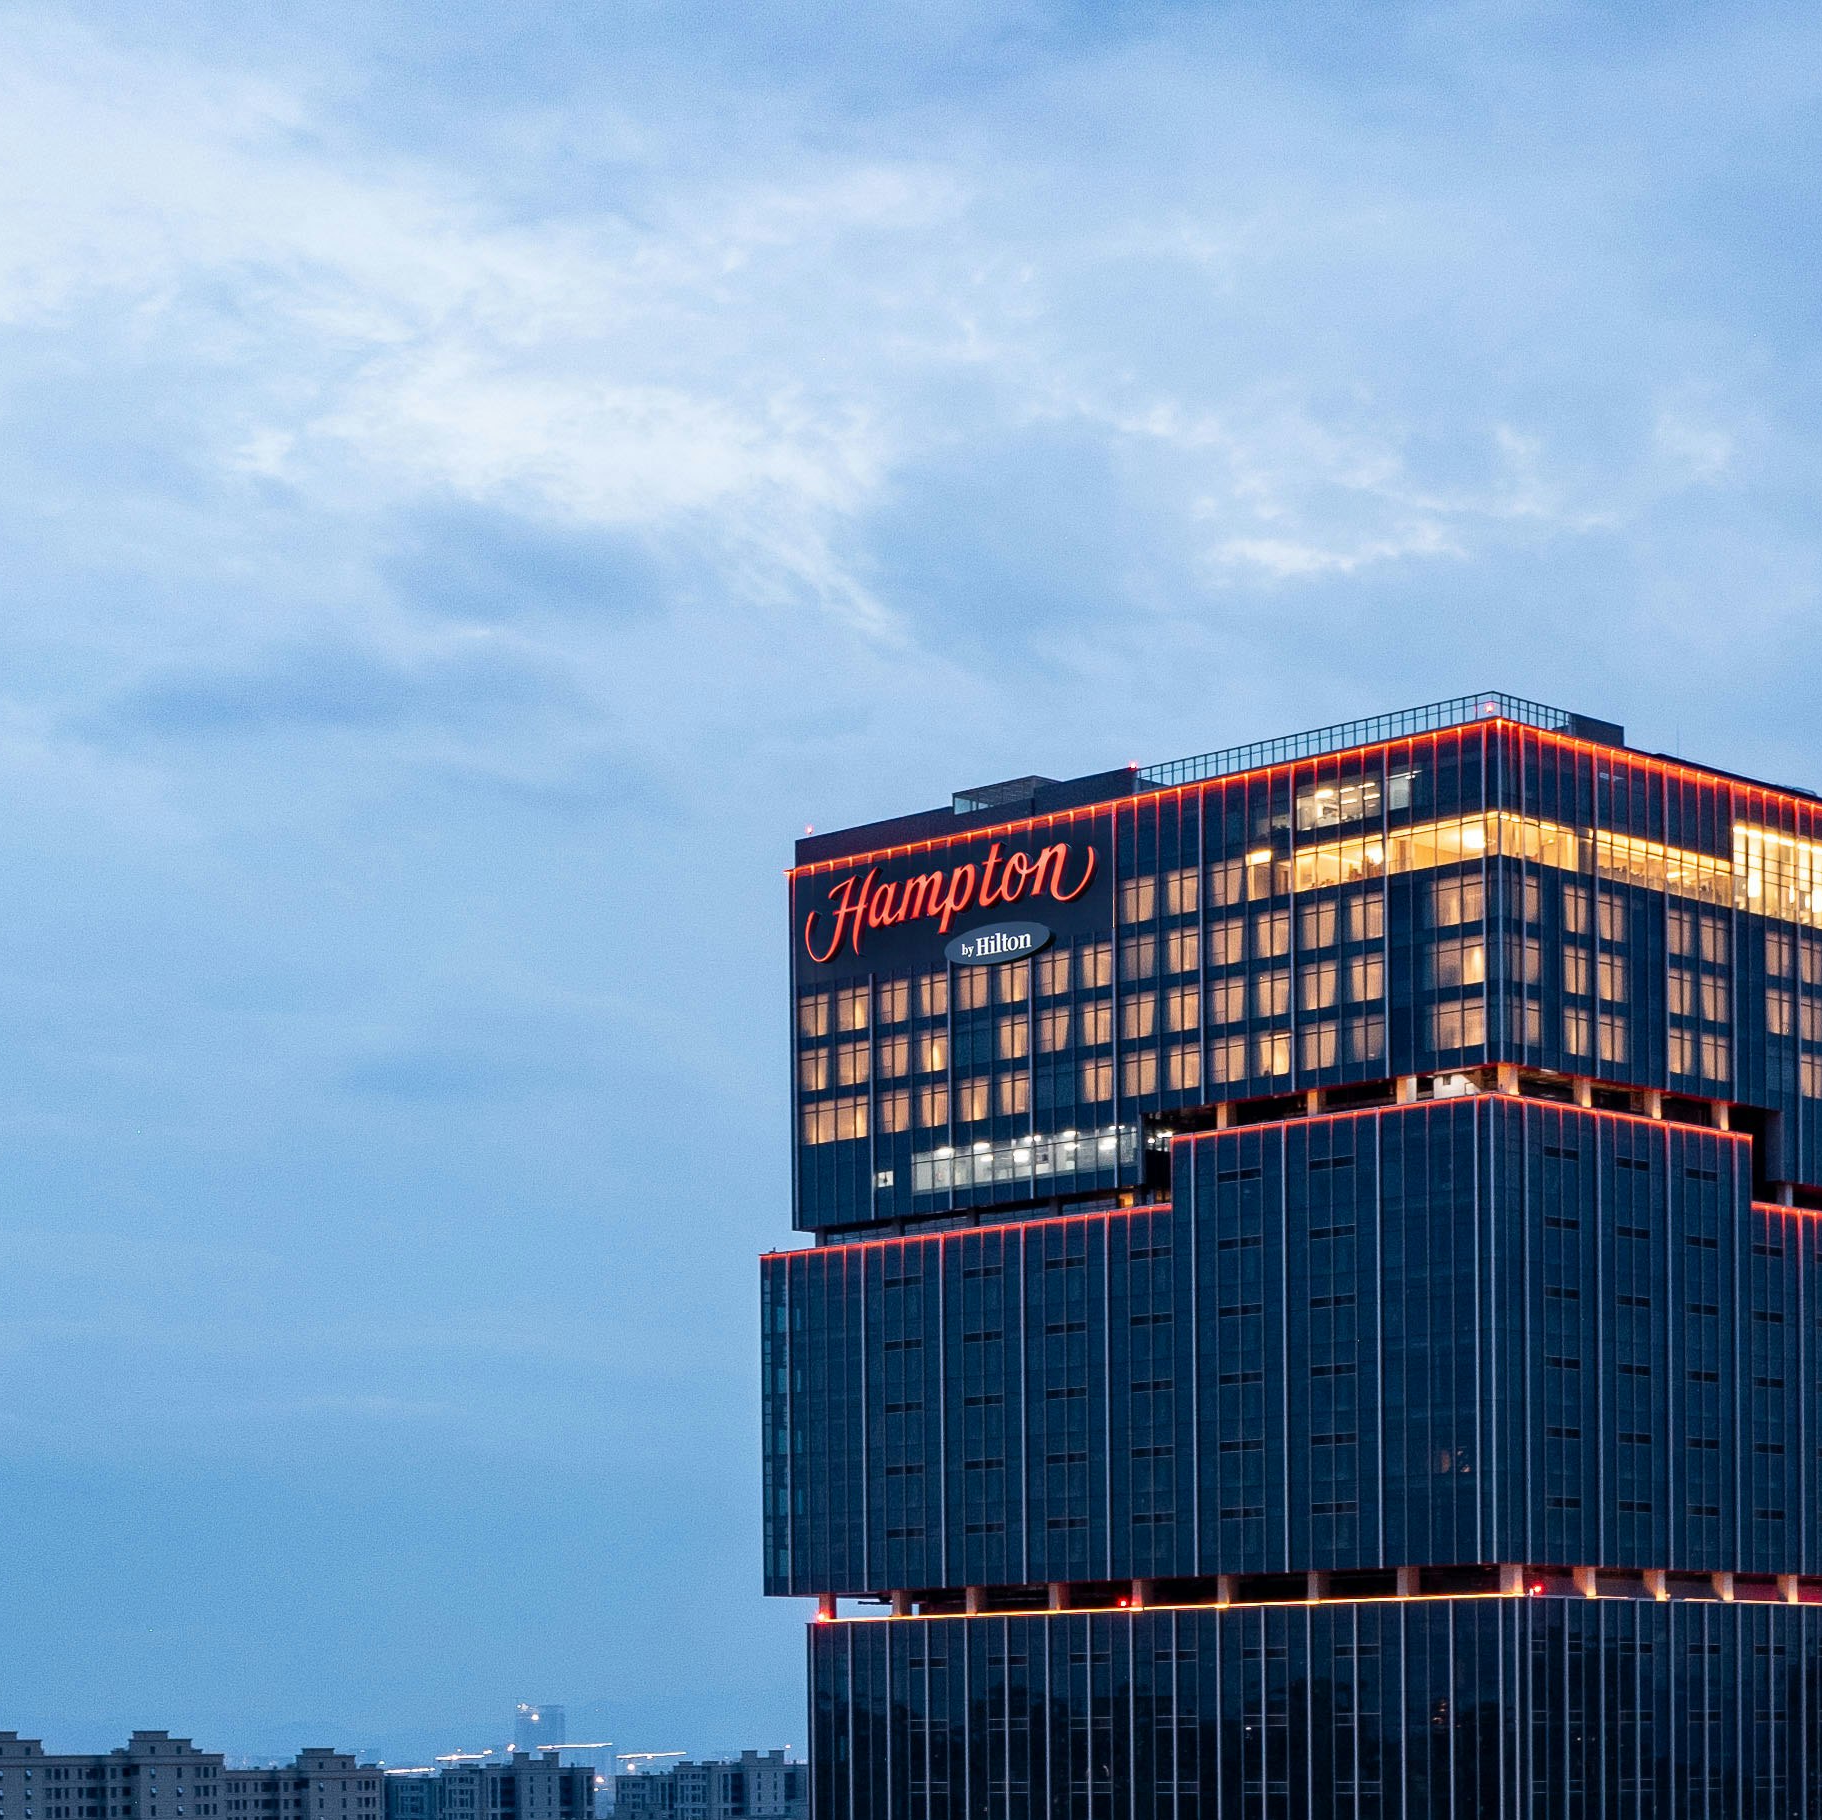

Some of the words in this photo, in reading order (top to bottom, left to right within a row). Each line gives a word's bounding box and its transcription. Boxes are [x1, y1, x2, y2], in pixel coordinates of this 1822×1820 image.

[805, 842, 1097, 963] Hampton
[961, 944, 974, 957] by
[976, 930, 1032, 956] Hilton
